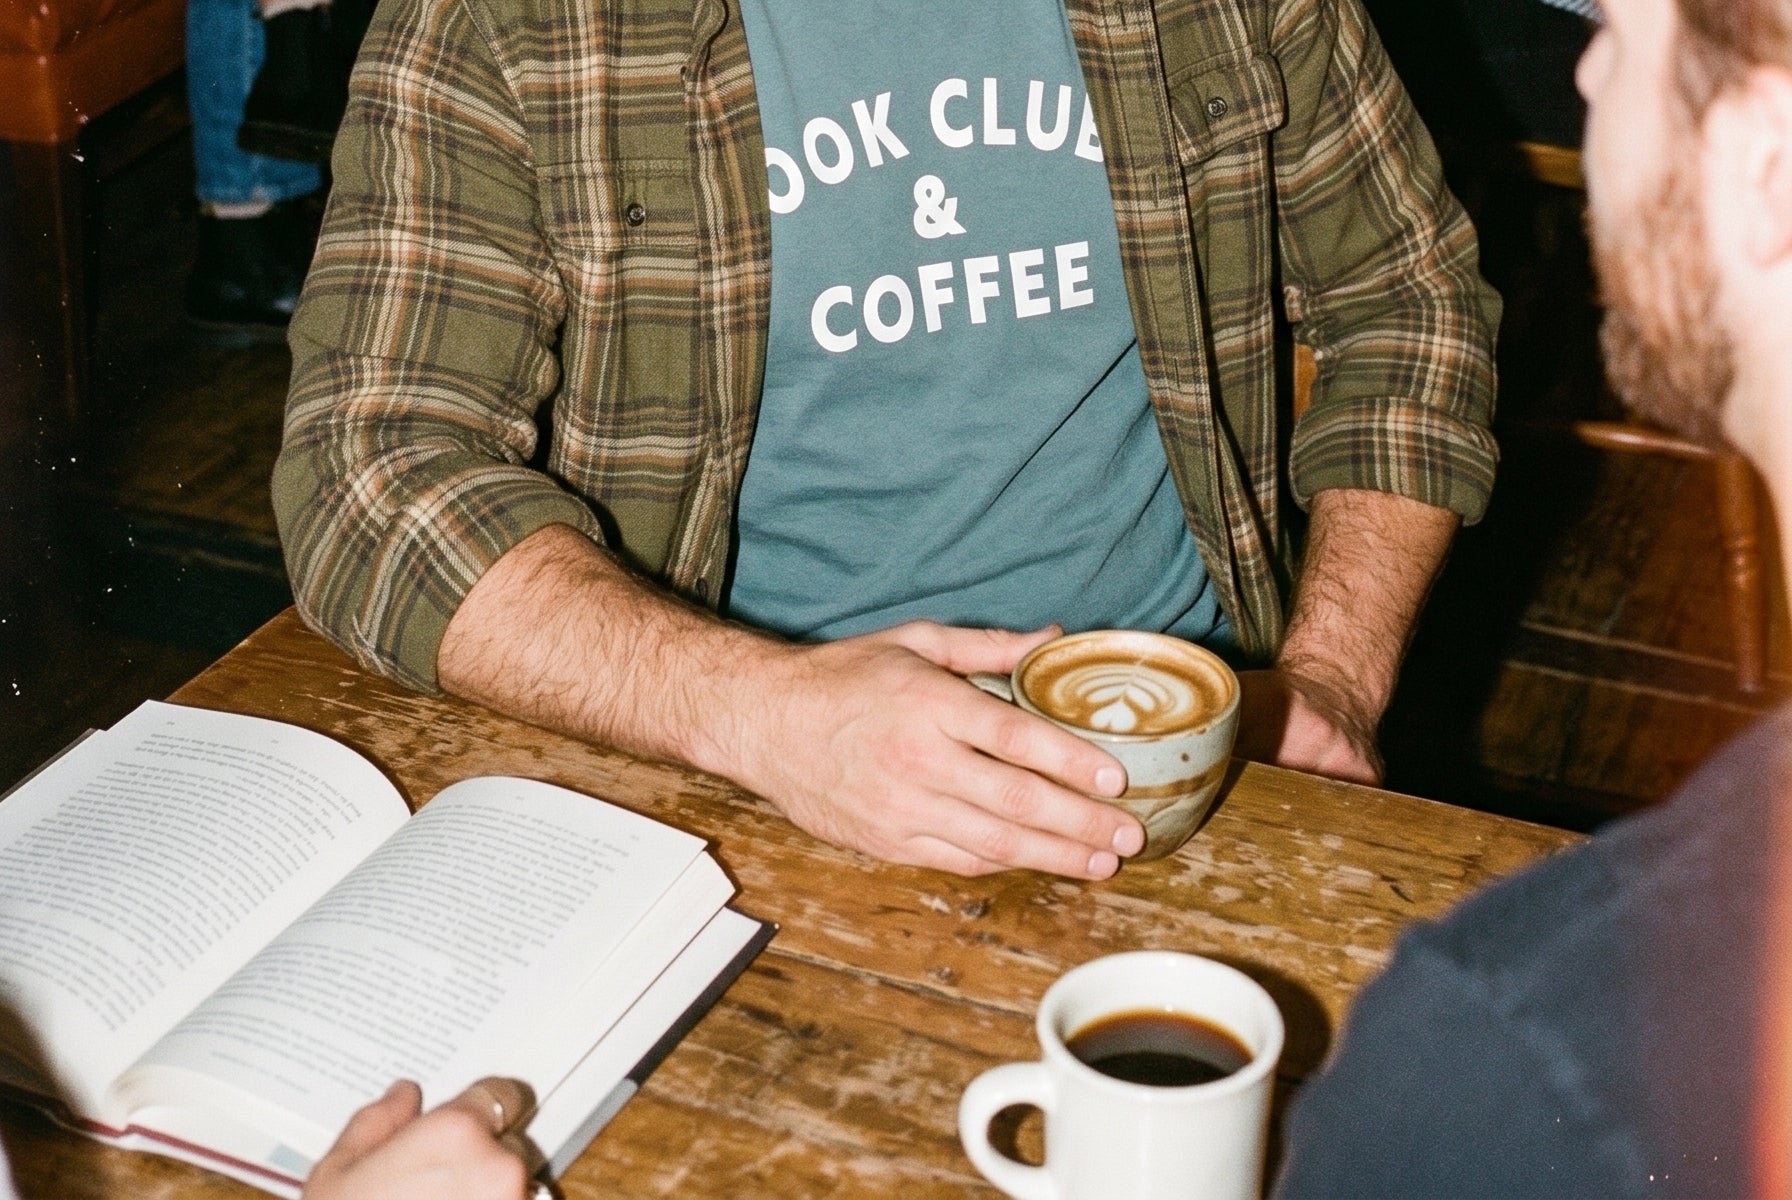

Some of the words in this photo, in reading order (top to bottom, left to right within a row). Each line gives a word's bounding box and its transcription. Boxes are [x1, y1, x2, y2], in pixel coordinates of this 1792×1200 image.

[764, 92, 910, 215] OOK
[913, 174, 967, 239] &
[810, 240, 1094, 353] COFFEE
